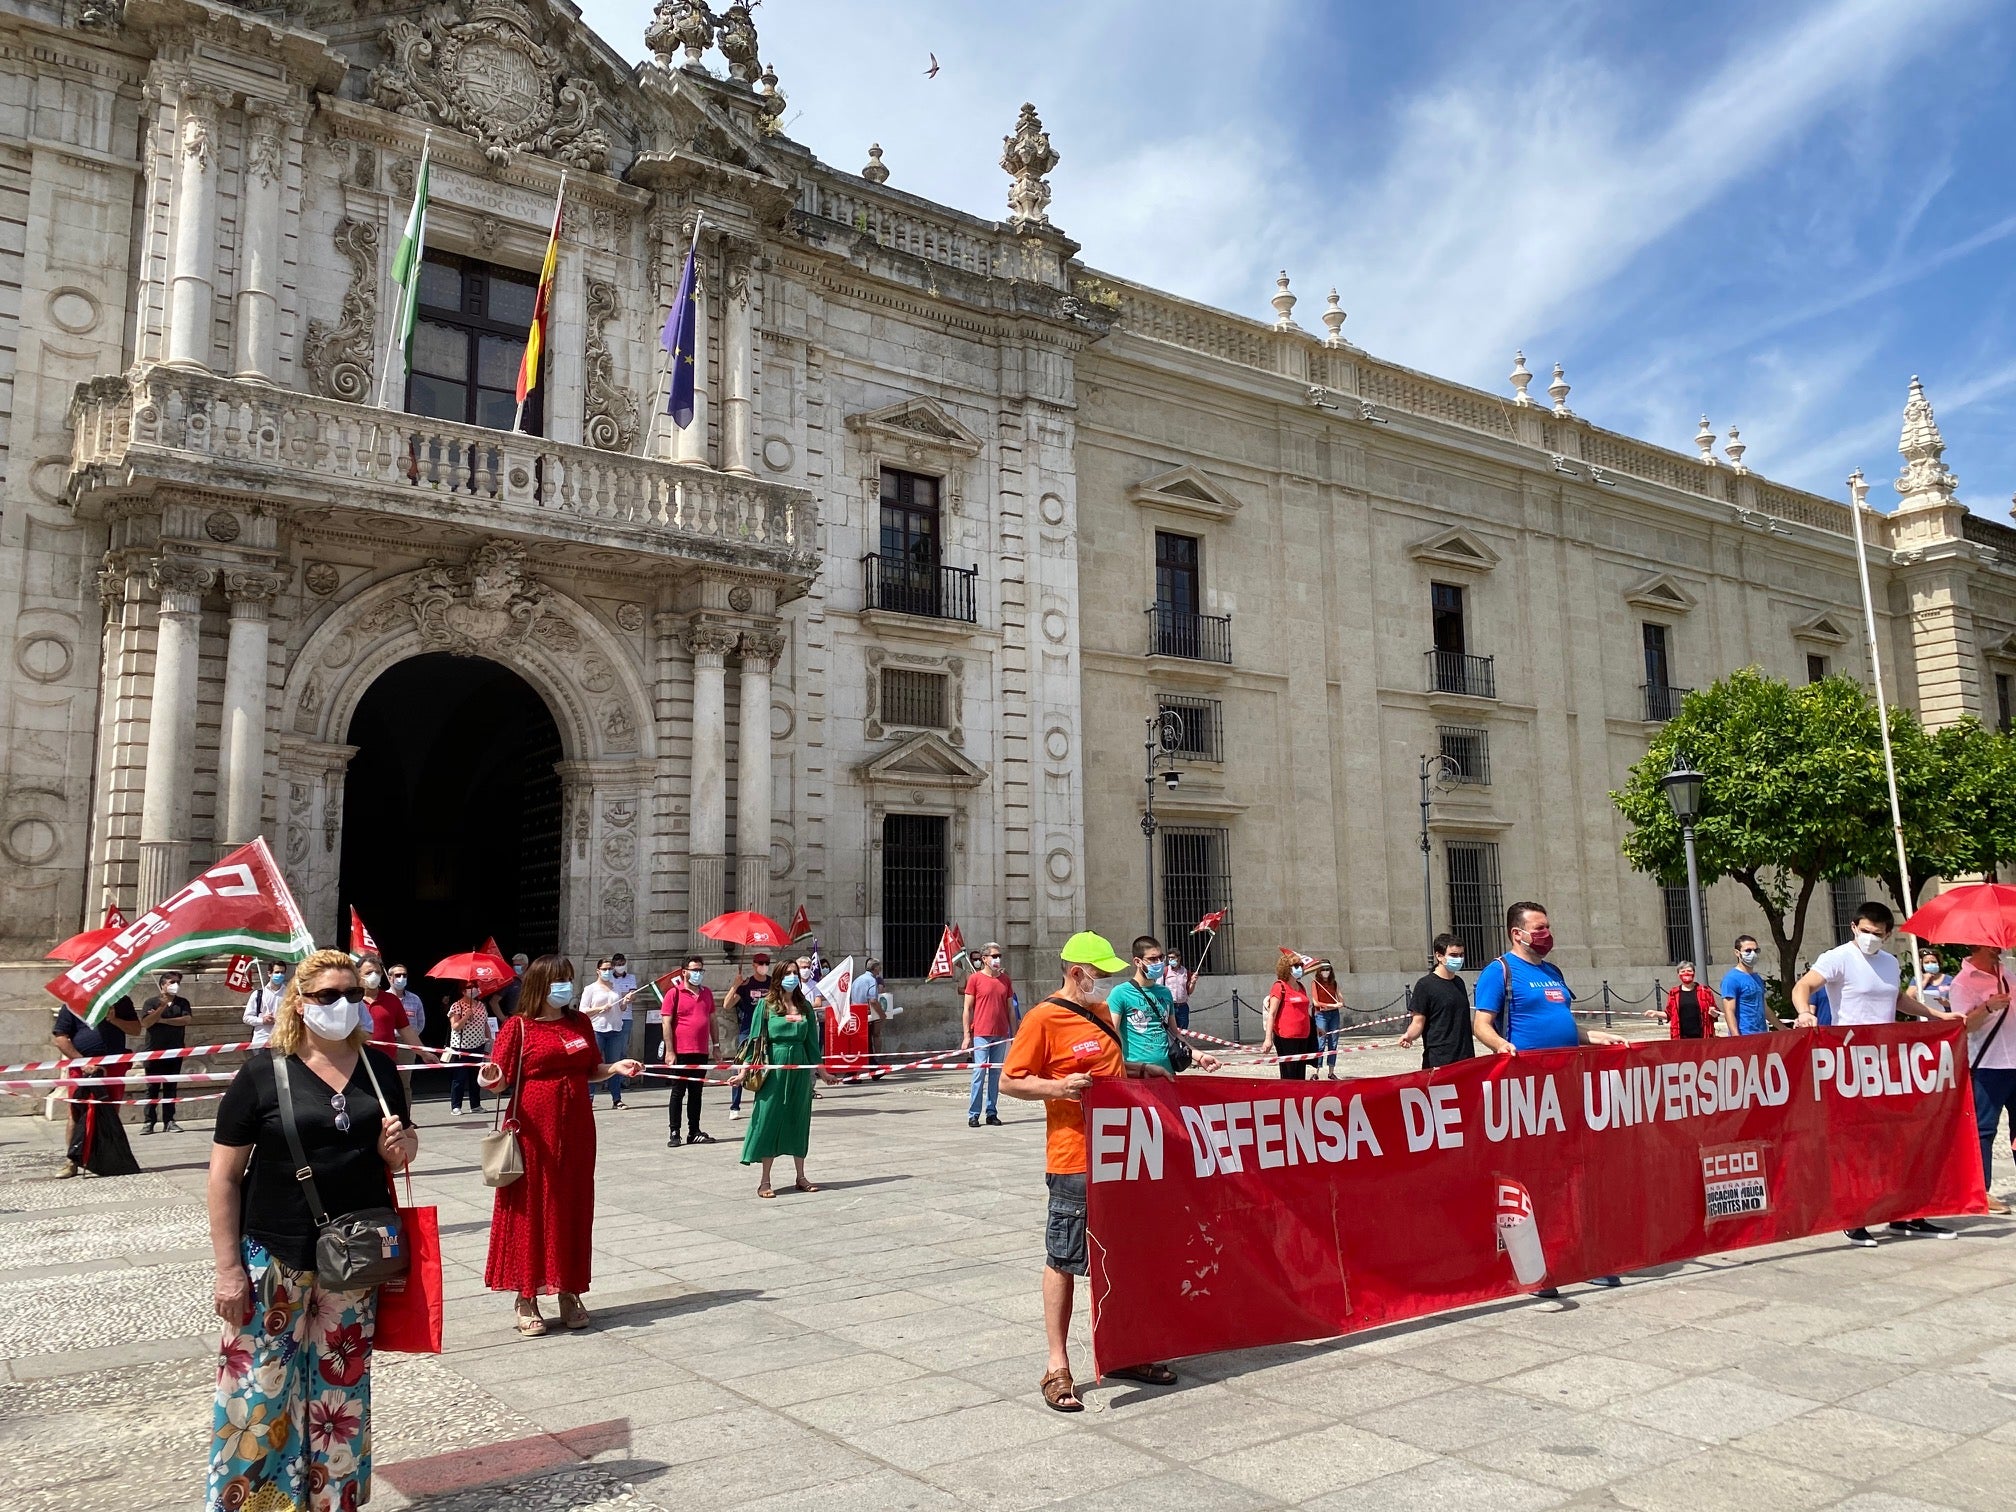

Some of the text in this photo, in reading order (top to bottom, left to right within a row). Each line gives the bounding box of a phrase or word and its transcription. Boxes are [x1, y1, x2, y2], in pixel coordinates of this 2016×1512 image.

[1092, 1029, 1956, 1184] EN DEFENSA DE UNA UNIVERSIDAD PÚBLICA
[1703, 1151, 1759, 1178] CCOO
[1740, 1197, 1761, 1212] NO
